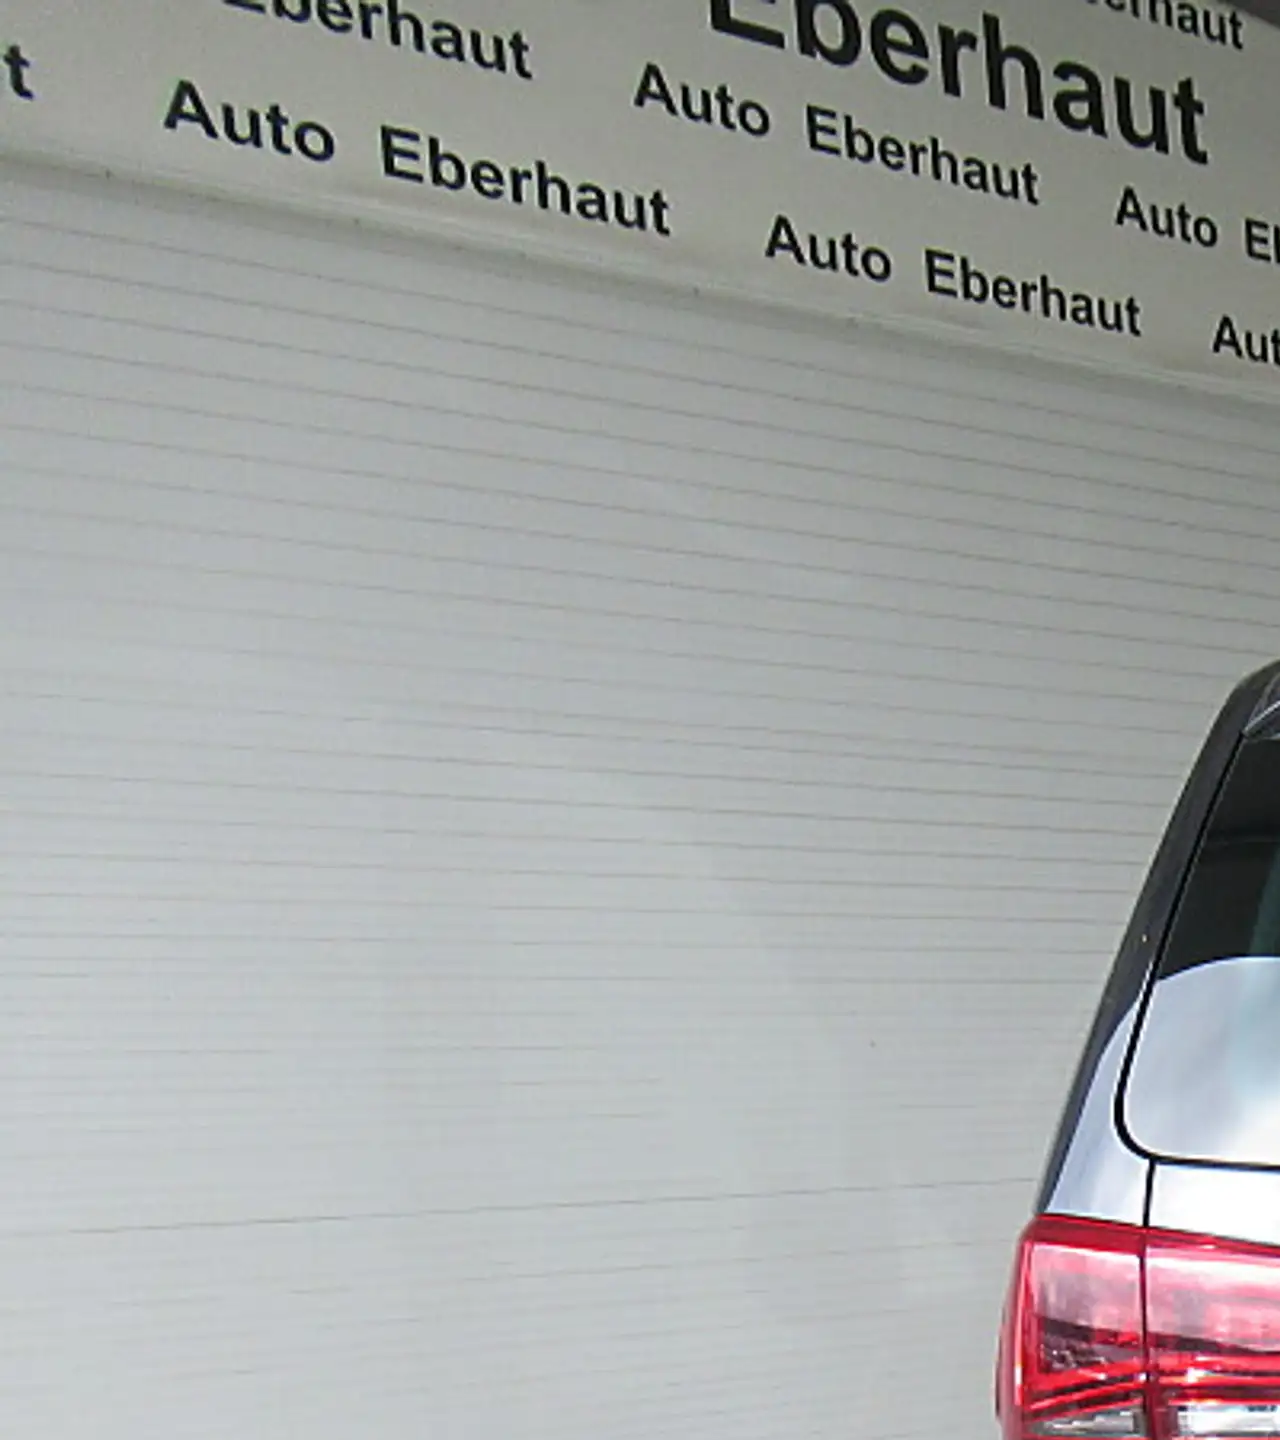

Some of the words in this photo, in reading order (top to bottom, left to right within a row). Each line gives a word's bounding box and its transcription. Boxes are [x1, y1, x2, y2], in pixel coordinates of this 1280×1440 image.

[164, 80, 335, 162] Auto
[380, 125, 671, 237] Eberhaut
[634, 62, 770, 137] Auto
[806, 104, 1040, 206] Eberhaut
[765, 214, 892, 283] Auto
[924, 248, 1142, 338] Eberhaut
[1115, 185, 1218, 249] Auto
